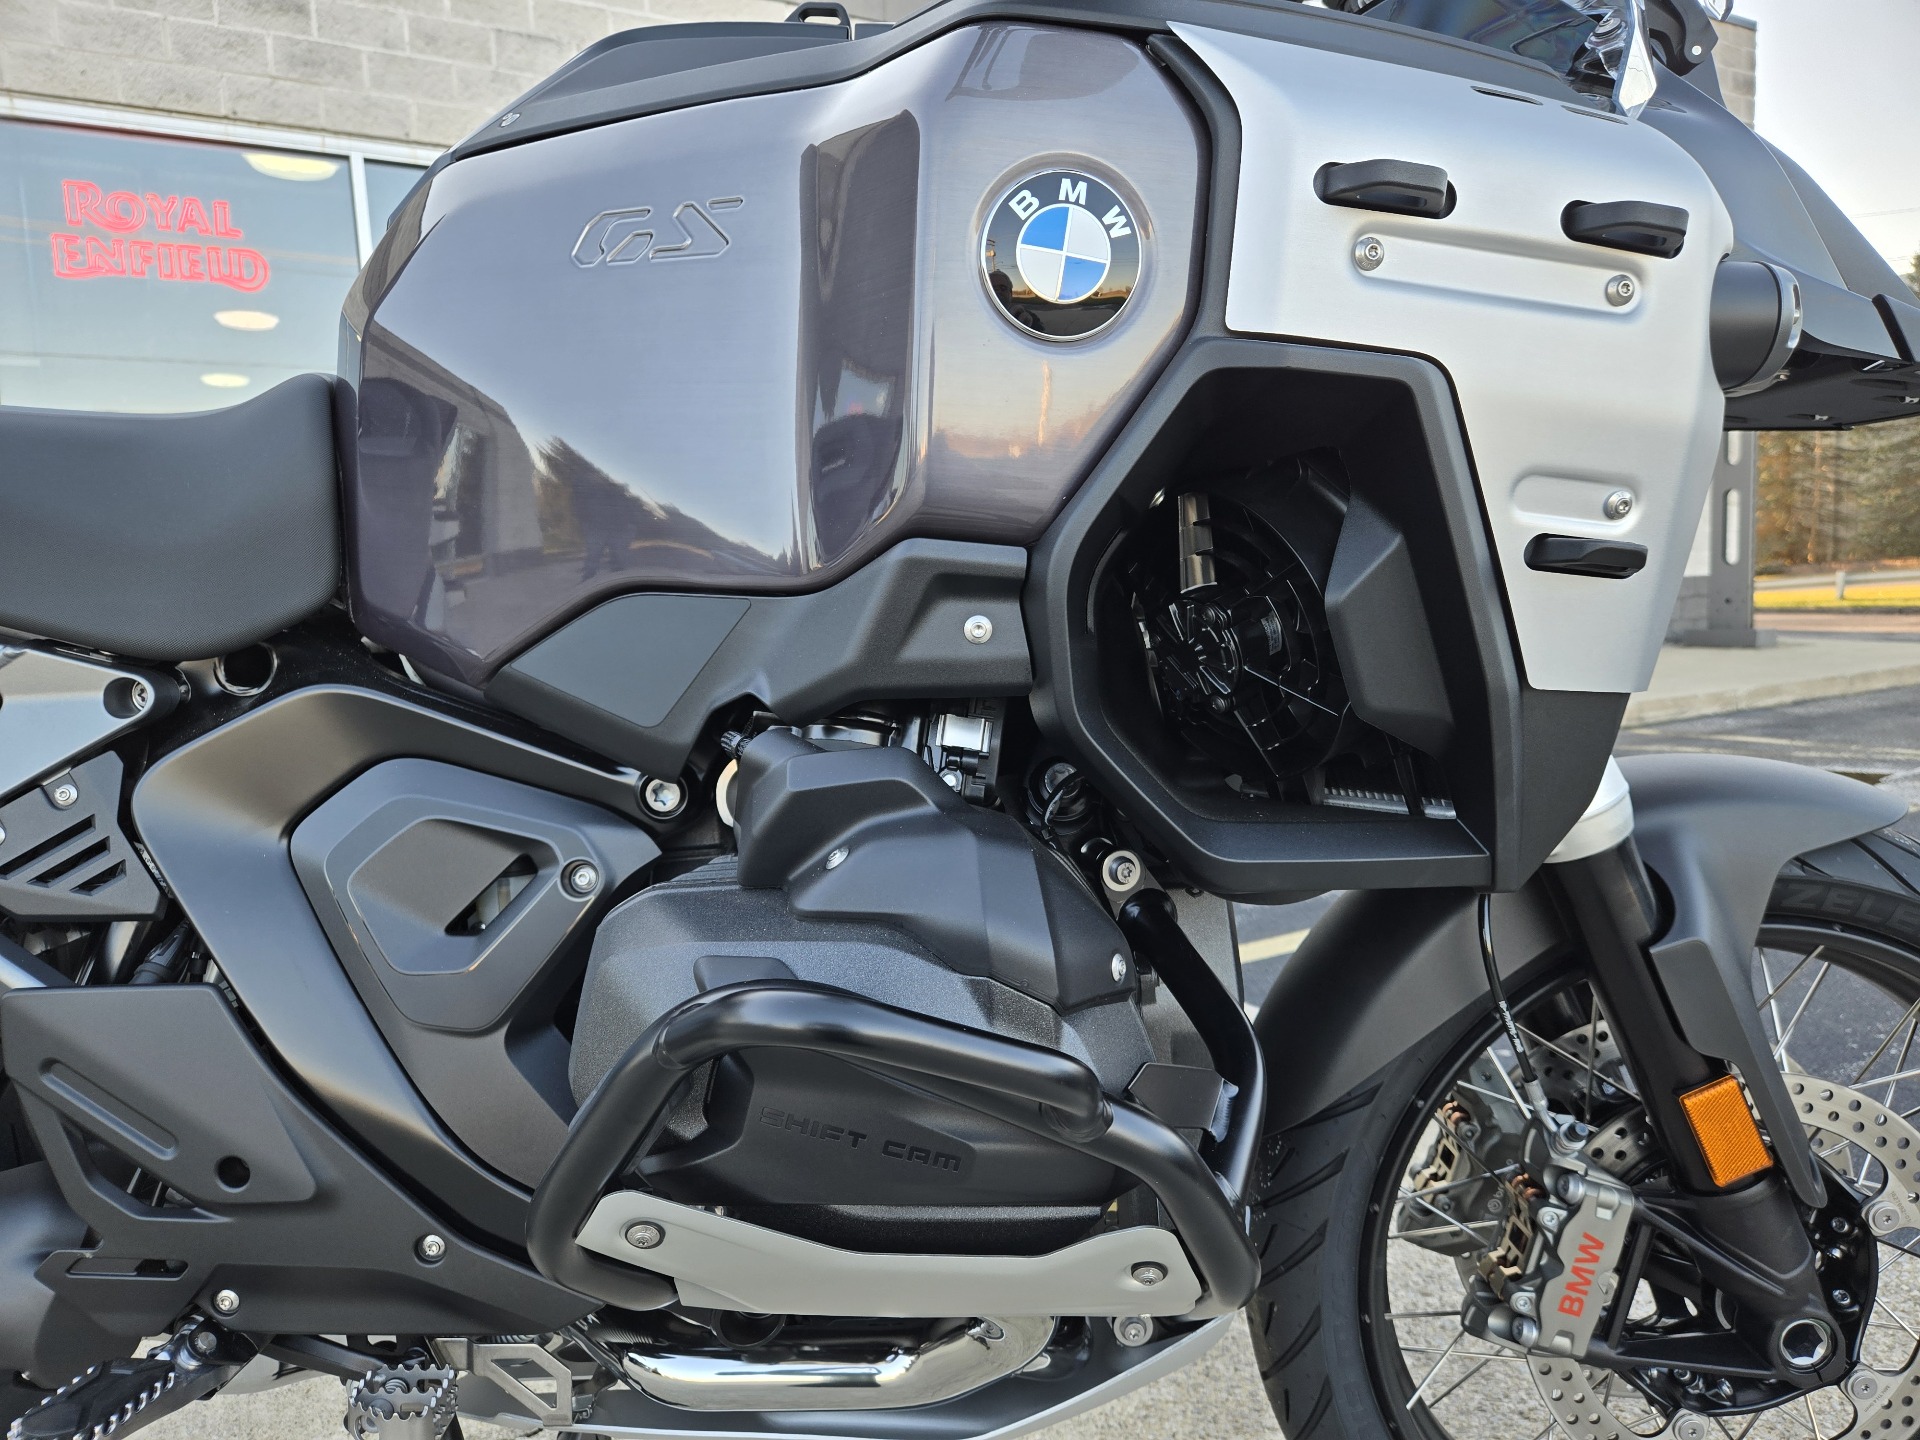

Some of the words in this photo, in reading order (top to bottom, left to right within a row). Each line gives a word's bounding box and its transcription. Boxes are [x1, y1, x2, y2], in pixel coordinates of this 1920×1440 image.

[61, 178, 243, 239] ROYAL
[571, 196, 744, 268] GS
[1008, 178, 1132, 239] BMW
[50, 232, 270, 293] ENFIELD
[759, 1105, 868, 1150] SHIFT
[882, 1139, 962, 1173] CAM
[1557, 1231, 1605, 1317] BMW
